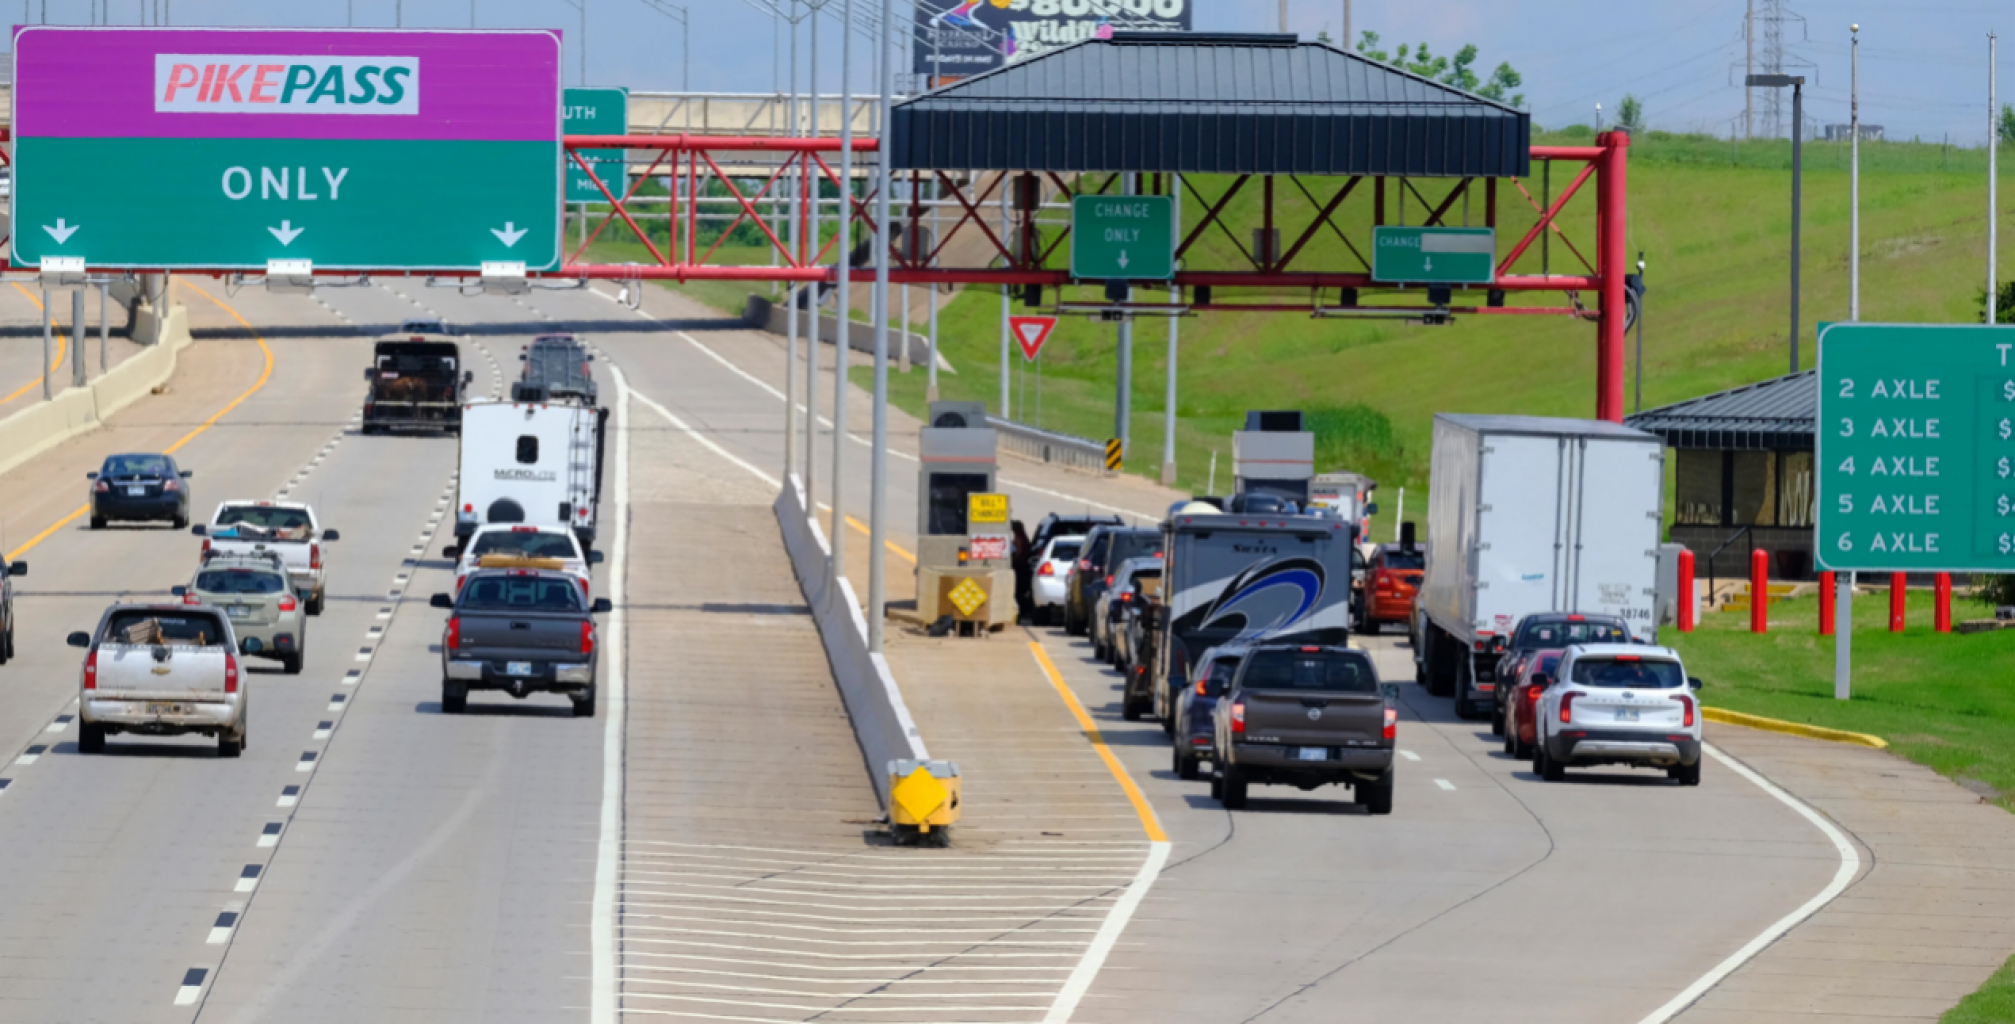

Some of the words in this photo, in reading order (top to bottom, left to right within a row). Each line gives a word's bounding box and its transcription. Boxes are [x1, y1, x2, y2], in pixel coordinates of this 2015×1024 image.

[163, 63, 411, 105] PIKEPASS
[221, 165, 349, 201] ONLY
[1095, 203, 1150, 218] CHANGE
[1104, 228, 1140, 242] ONLY
[1379, 236, 1421, 248] CHANGE
[1839, 379, 1855, 398] 2
[1871, 378, 1940, 399] AXLE
[1839, 418, 1855, 437] 3
[1871, 418, 1940, 438] AXLE
[1838, 456, 1856, 475] 4
[1870, 456, 1940, 476] AXLE
[1838, 494, 1854, 513] 5
[1870, 494, 1940, 515] AXLE
[1837, 532, 1853, 552] 6
[1870, 532, 1940, 553] AXLE
